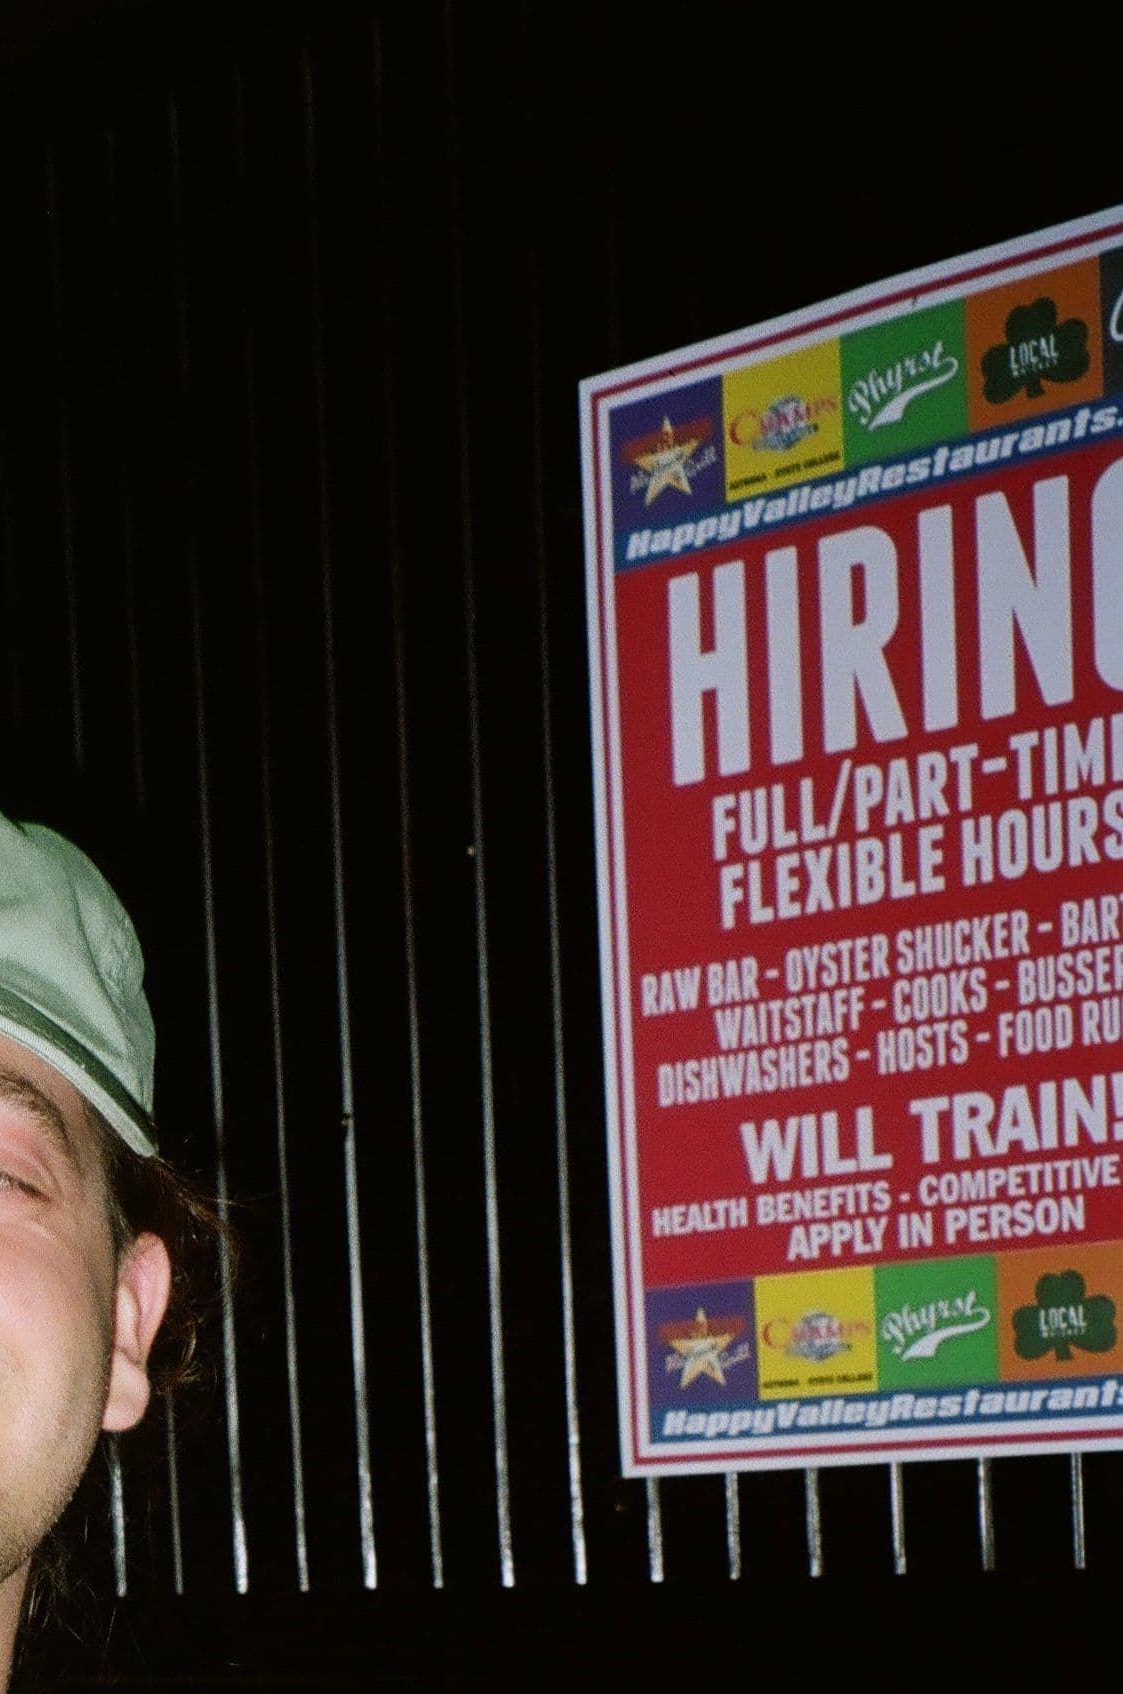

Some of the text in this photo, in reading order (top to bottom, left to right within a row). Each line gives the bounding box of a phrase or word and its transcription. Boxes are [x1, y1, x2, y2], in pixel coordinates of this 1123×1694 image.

[1009, 334, 1058, 369] LOCAL
[720, 788, 1123, 930] FLEXIBLE HOURS
[641, 965, 700, 1017] RAW
[707, 956, 759, 1006] BAR
[785, 933, 889, 993] OYSTER
[896, 909, 1030, 974] SHUCKER
[1061, 892, 1123, 948] BAR
[714, 986, 865, 1050] WAITSTAFF
[893, 966, 988, 1025] COOKS
[658, 1037, 849, 1107] DISHWASHERS
[877, 1018, 969, 1075] HOSTS
[997, 1003, 1074, 1058] FOOD
[1081, 995, 1123, 1046] RU
[739, 1070, 1123, 1185] WILL TRAIN!
[652, 1196, 747, 1237] HEALTH
[757, 1181, 891, 1224] BENEFITS
[918, 1153, 1121, 1207] COMPETITIVE
[787, 1194, 1085, 1261] APPLY IN PERSON
[1039, 1304, 1087, 1330] LOCAL
